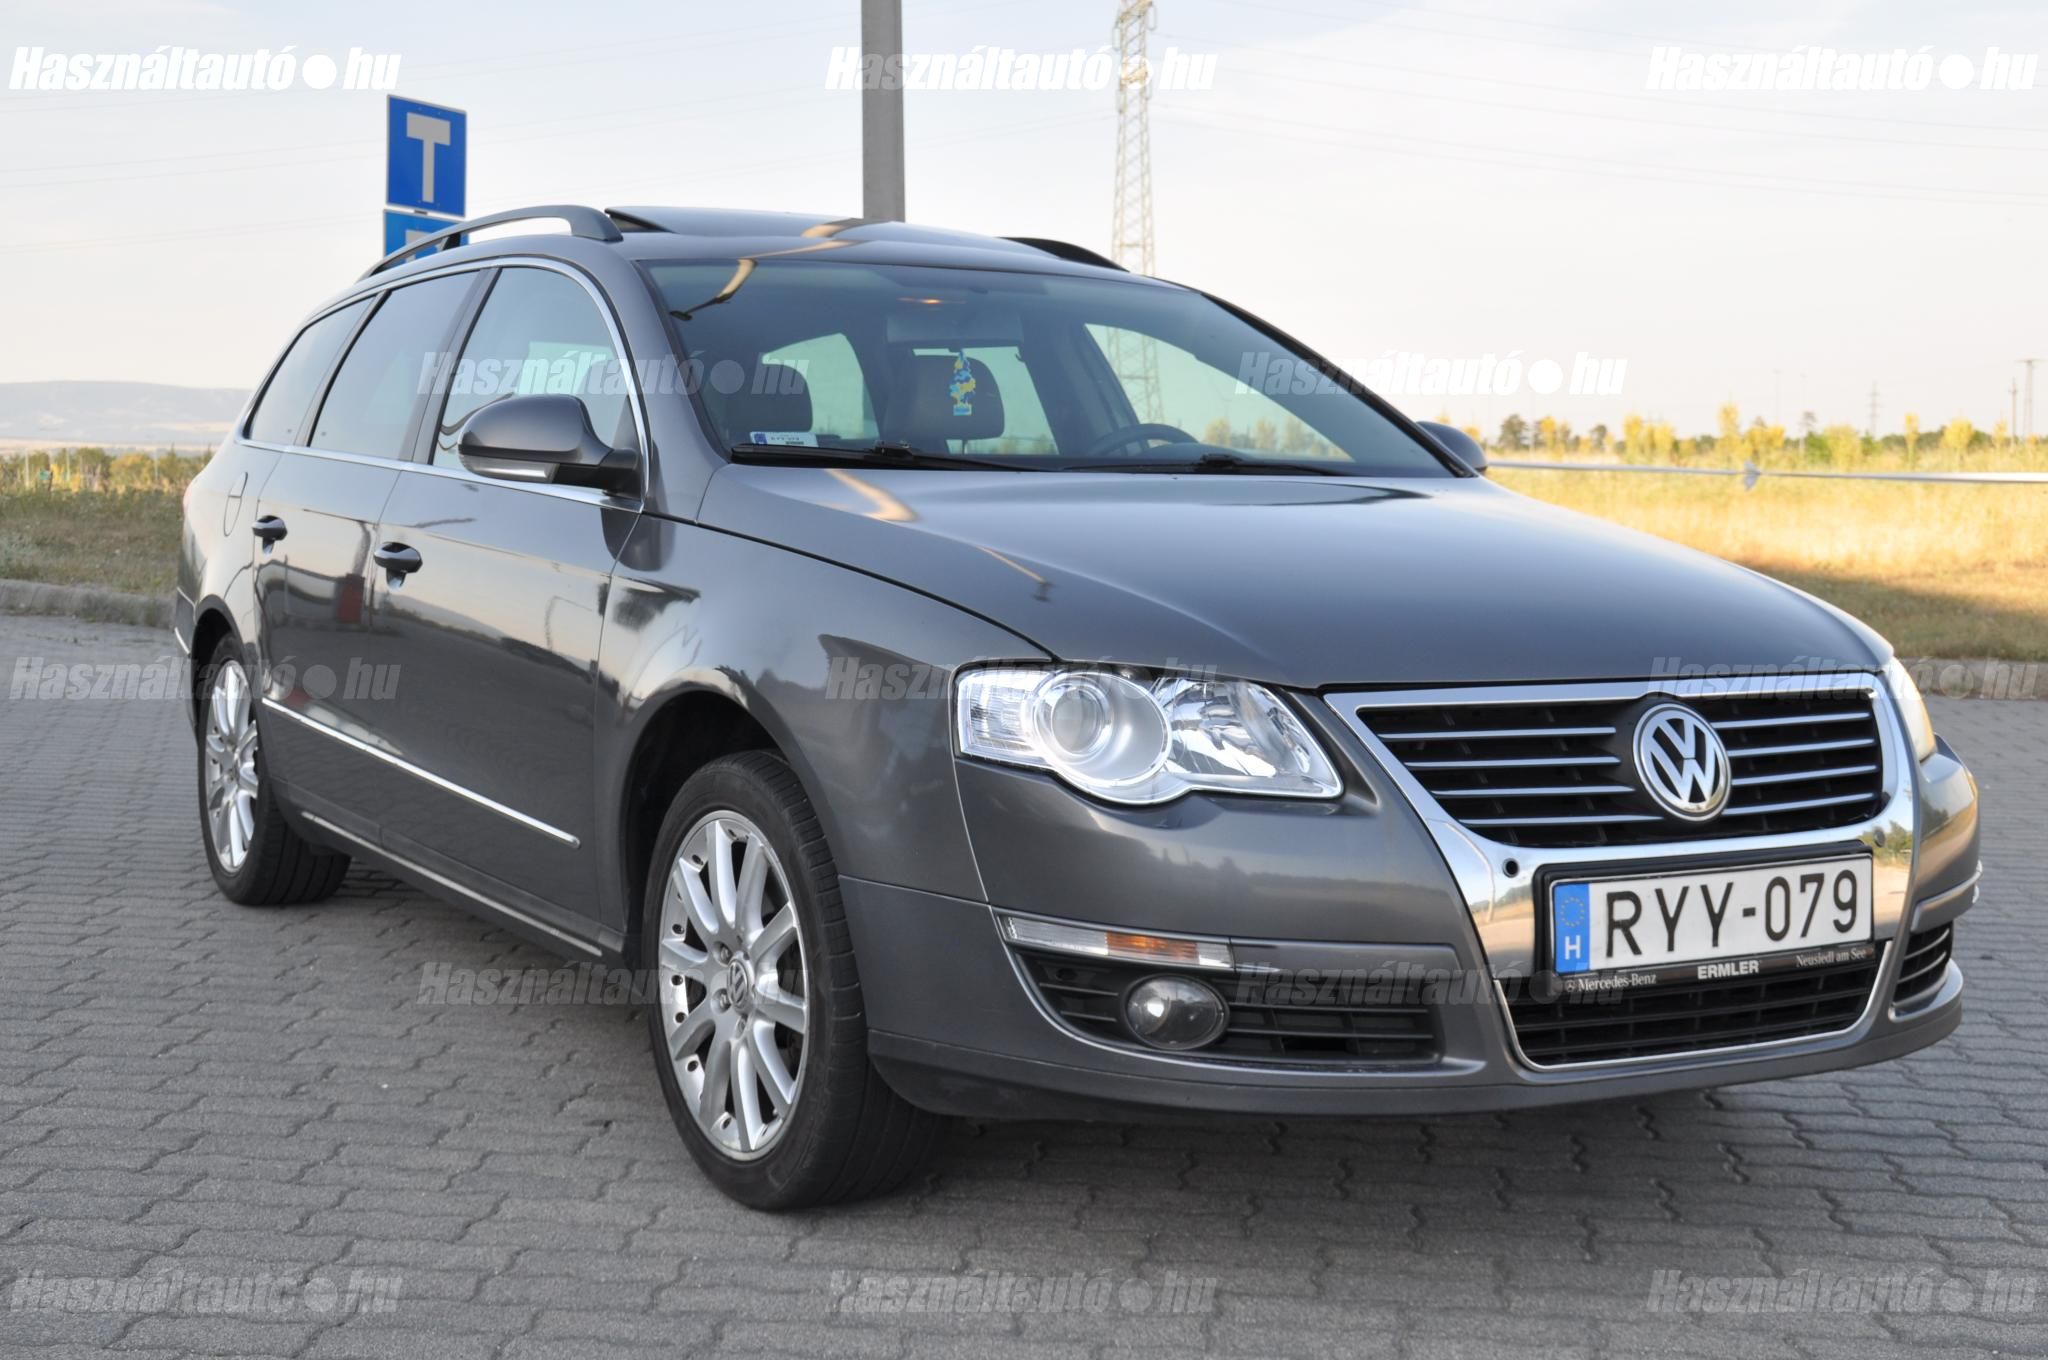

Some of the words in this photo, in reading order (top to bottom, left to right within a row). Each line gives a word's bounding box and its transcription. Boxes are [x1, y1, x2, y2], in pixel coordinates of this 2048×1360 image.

[1606, 869, 1857, 958] RYY-079
[1564, 935, 1581, 960] H
[1697, 960, 1759, 980] ERMLER
[1578, 973, 1657, 992] Mercedes-Benz
